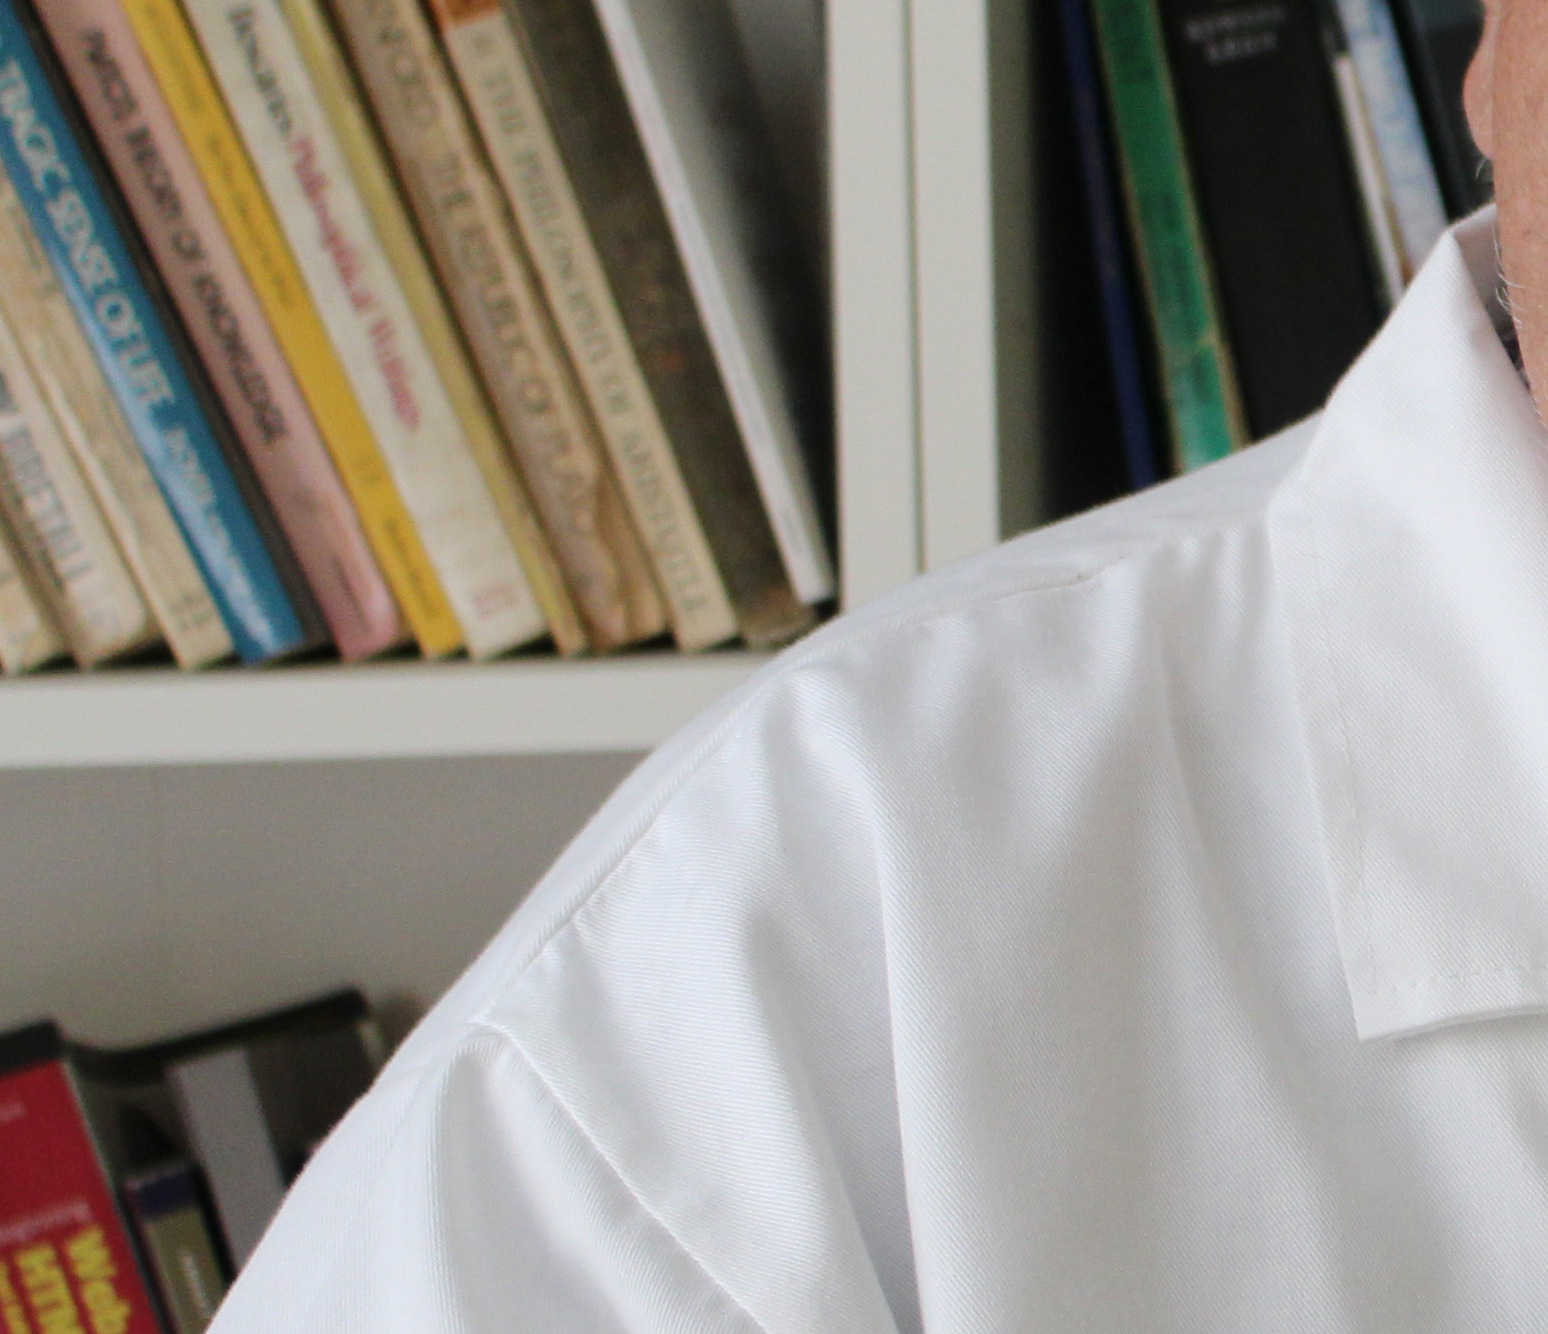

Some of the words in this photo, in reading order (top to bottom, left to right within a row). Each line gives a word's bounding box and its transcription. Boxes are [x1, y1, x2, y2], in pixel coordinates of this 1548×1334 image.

[0, 56, 75, 195] TRAGIC
[41, 185, 121, 297] SENSE
[121, 123, 189, 223] THEORY
[166, 221, 210, 268] OF
[189, 266, 292, 448] KNOWLEDGE
[423, 151, 475, 214] THE
[451, 219, 539, 373] REPUBLIC
[510, 368, 558, 421] OF
[90, 285, 144, 344] OF
[113, 333, 180, 419] LIFE
[480, 69, 531, 139] THE
[508, 146, 620, 370] PHILOSOPHY
[618, 428, 713, 614] ARISTOTLE
